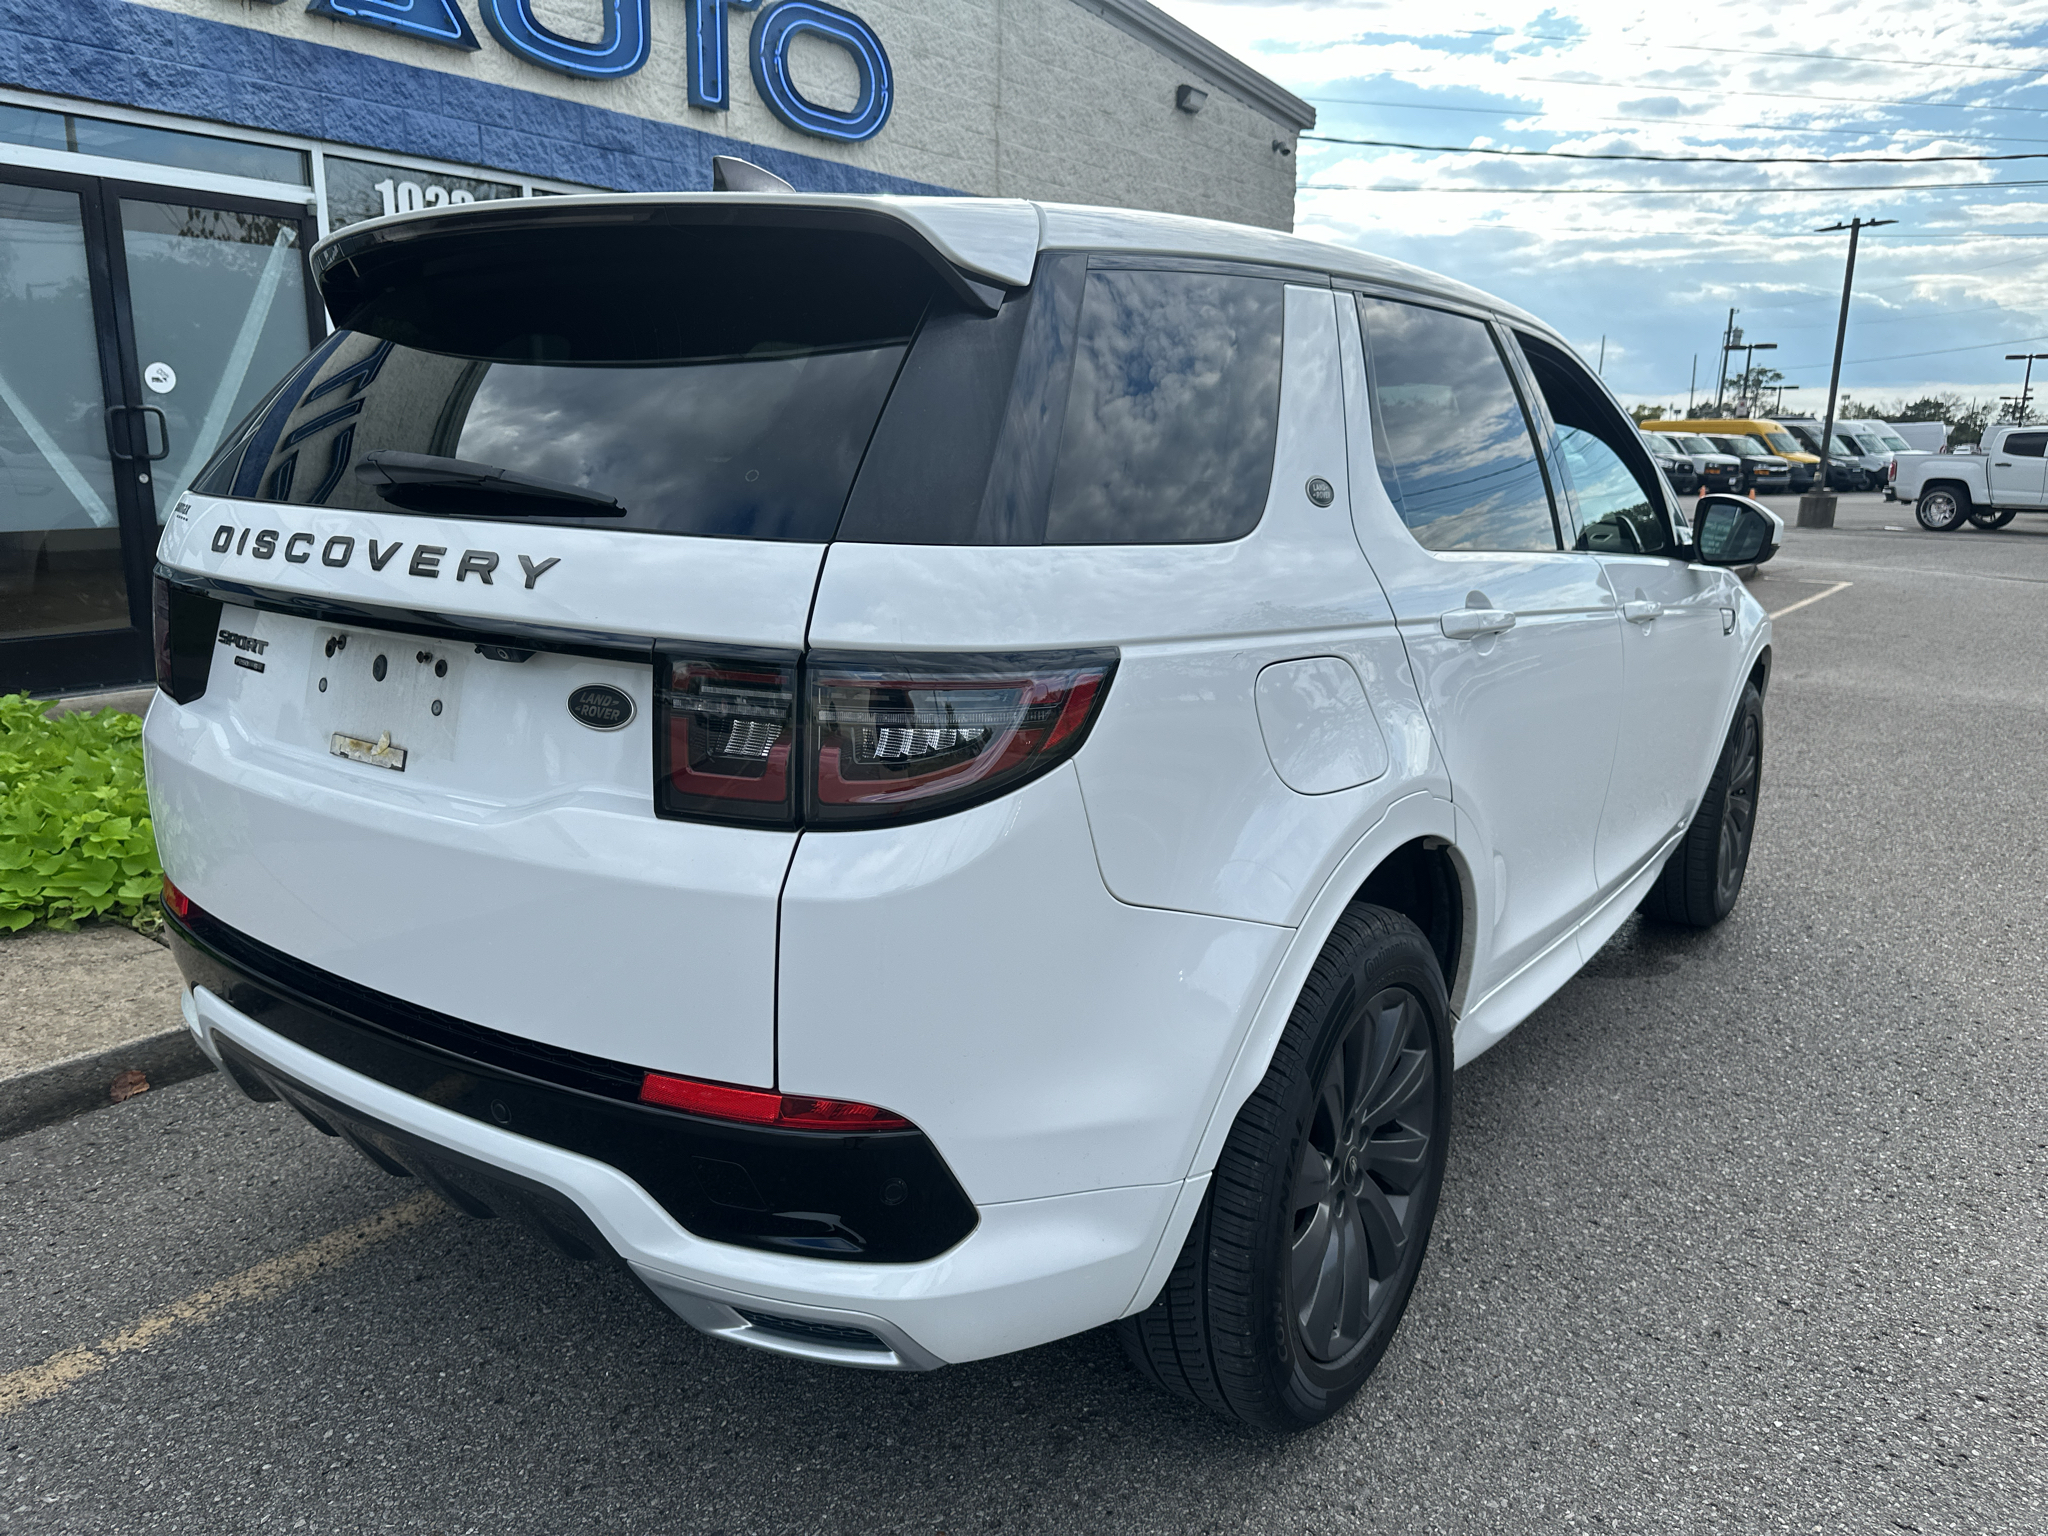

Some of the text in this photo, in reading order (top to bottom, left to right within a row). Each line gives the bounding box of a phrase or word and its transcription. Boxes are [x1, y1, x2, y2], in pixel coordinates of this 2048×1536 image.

[305, 0, 893, 142] UTO
[211, 525, 561, 590] DISCOVERY
[218, 629, 269, 656] SPORT
[579, 692, 613, 707] LAND
[580, 704, 621, 721] ROVER
